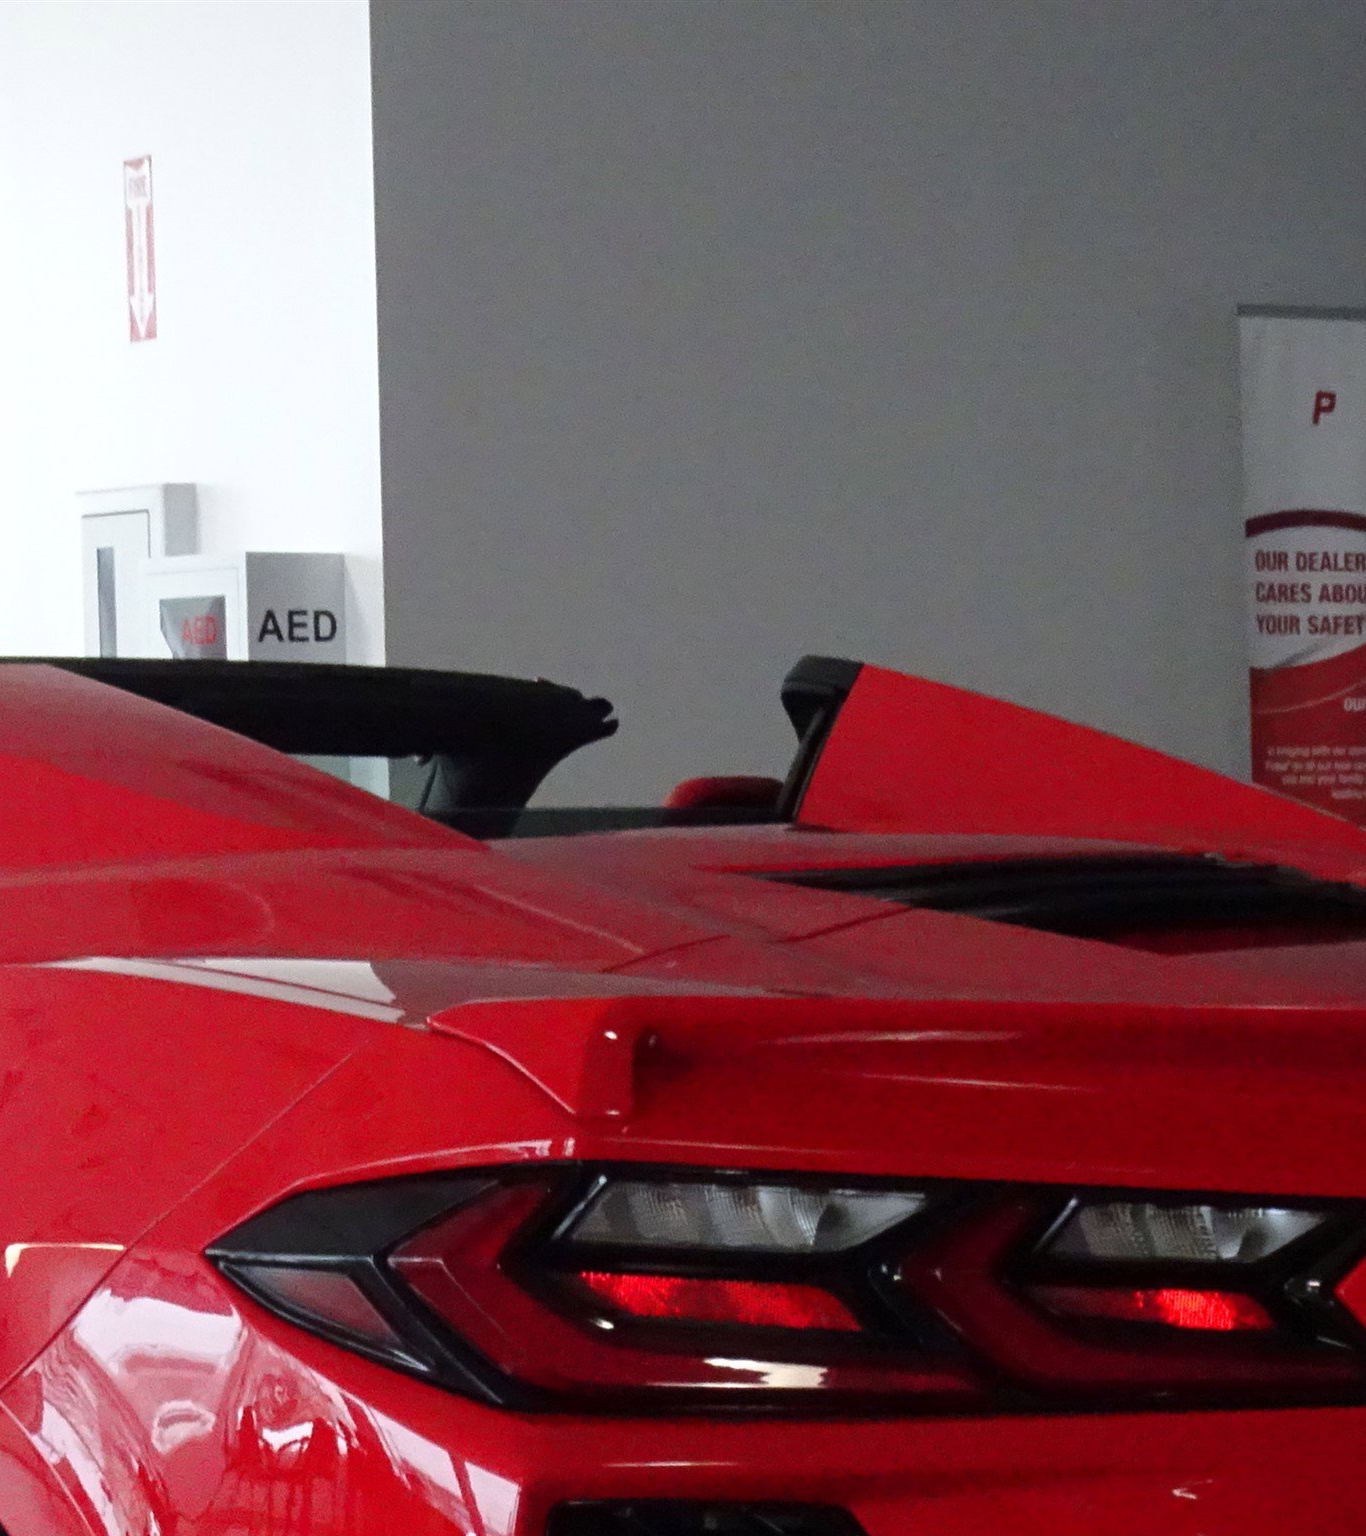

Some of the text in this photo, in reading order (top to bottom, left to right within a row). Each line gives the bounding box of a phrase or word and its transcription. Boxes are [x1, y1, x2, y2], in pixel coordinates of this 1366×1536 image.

[1255, 550, 1288, 572] OUR
[1255, 580, 1312, 603] CARES
[181, 614, 218, 645] AED
[258, 609, 337, 642] AED
[1256, 614, 1300, 635] YOUR
[1343, 697, 1366, 712] our
